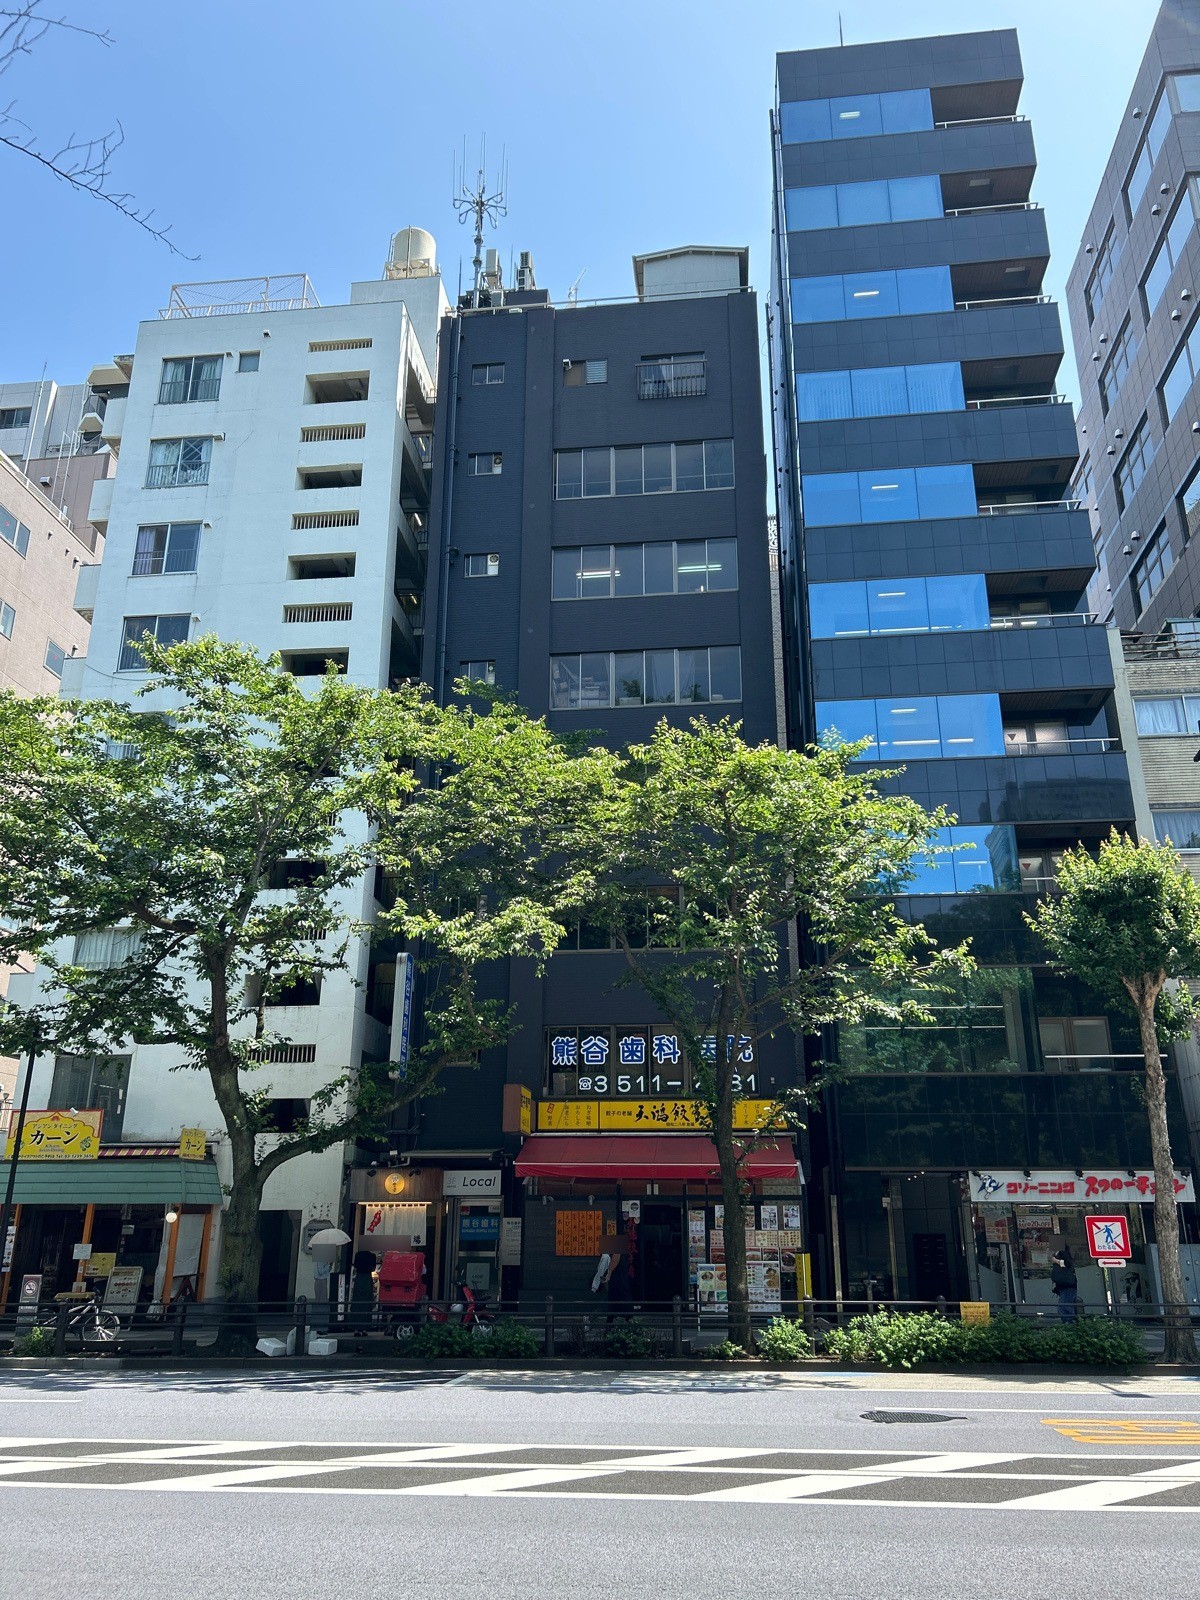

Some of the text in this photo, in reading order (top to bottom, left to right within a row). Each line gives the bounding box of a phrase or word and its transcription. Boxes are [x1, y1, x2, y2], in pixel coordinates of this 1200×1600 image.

[29, 1129, 79, 1145] カーン
[185, 1138, 203, 1152] カーン
[462, 1176, 497, 1187] Local
[1006, 1182, 1075, 1194] クリーニング
